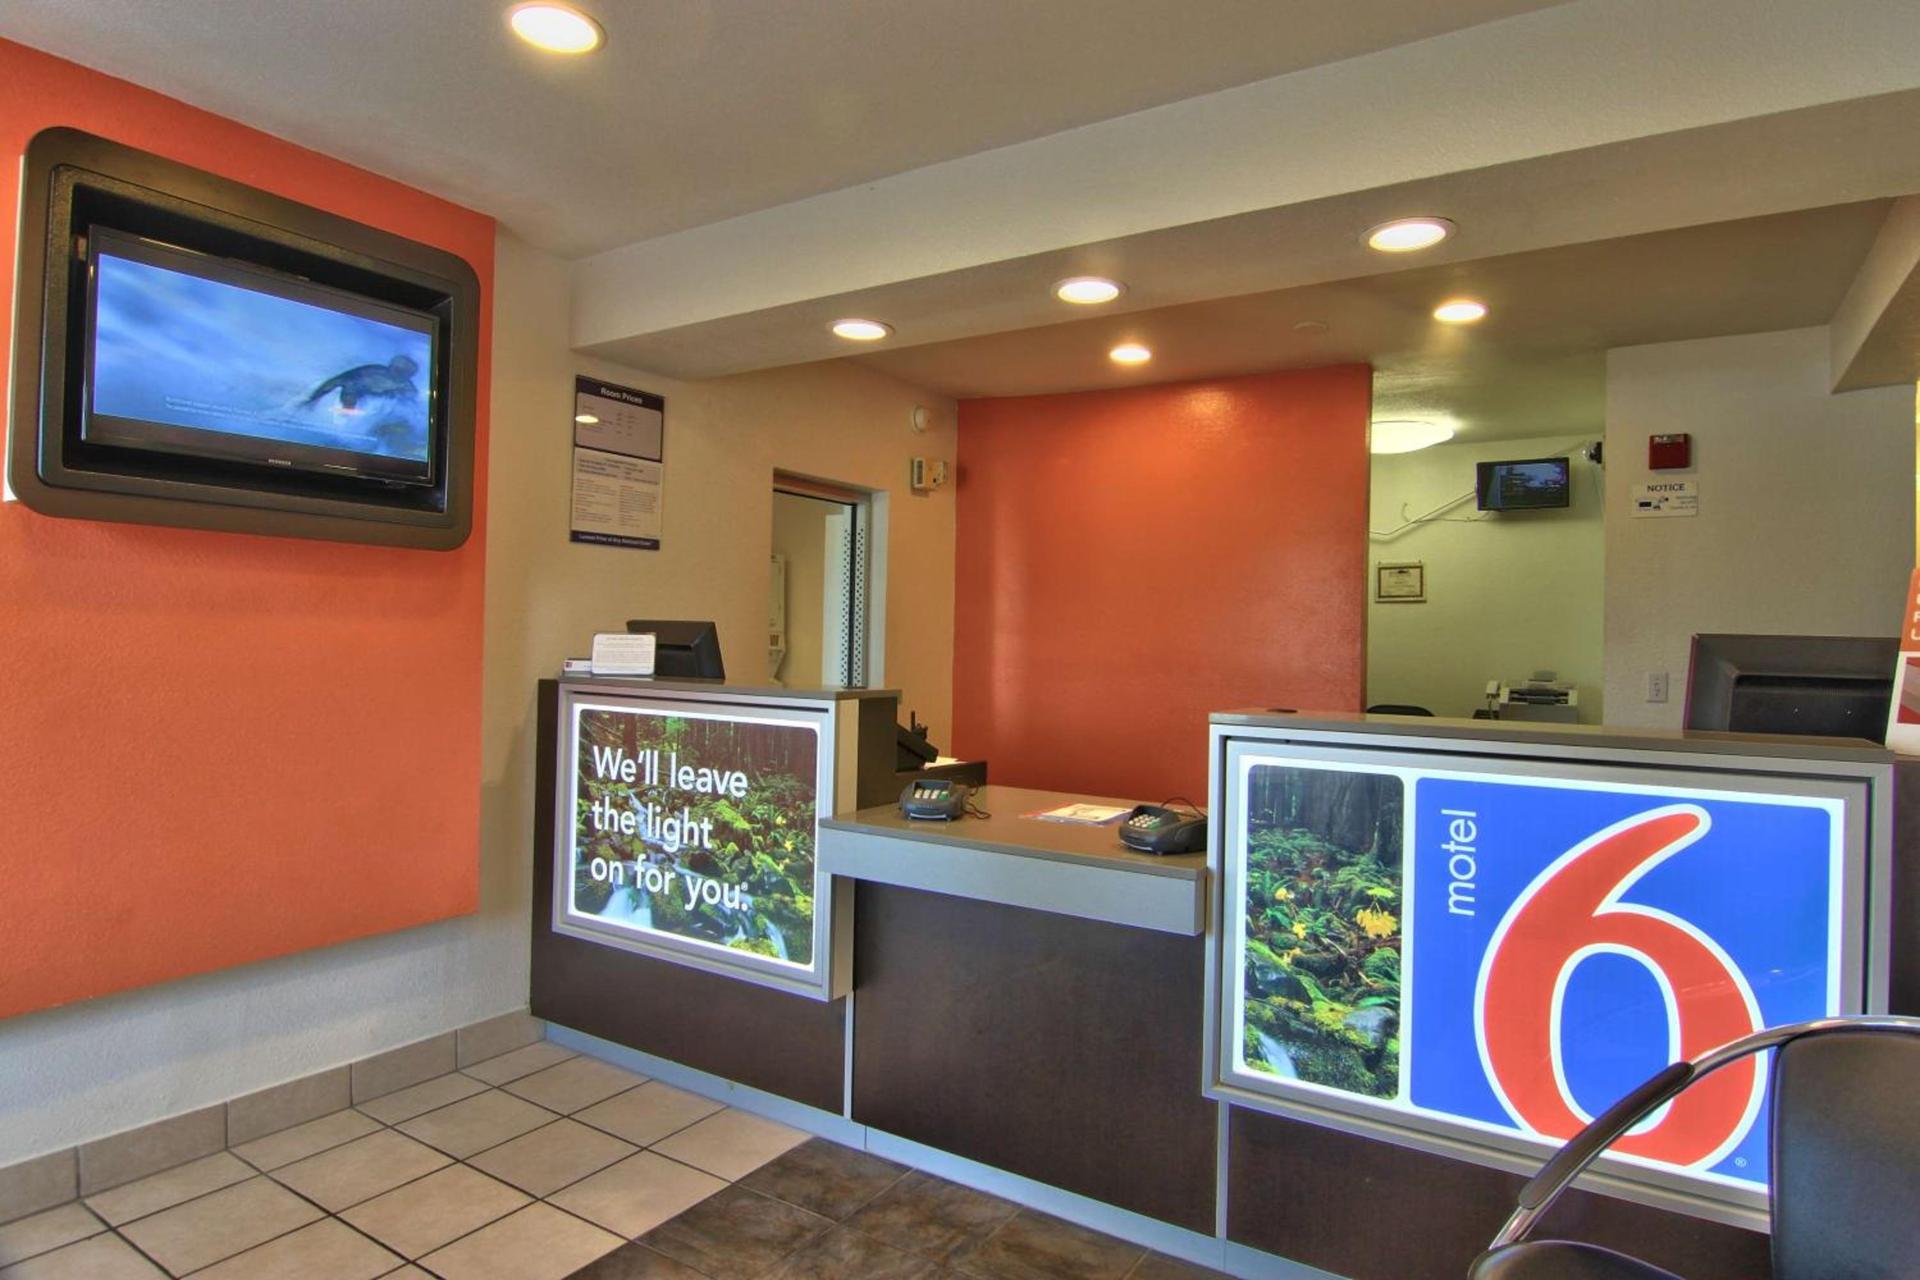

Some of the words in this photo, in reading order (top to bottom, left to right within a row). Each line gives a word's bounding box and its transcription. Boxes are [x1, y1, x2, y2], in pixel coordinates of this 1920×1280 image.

[600, 386, 620, 398] Room
[622, 391, 643, 404] Prices
[1646, 482, 1686, 493] NOTICE
[592, 745, 659, 786] We'll
[670, 751, 749, 798] leave
[591, 795, 636, 835] the
[647, 801, 714, 853] light
[590, 857, 624, 886] on
[634, 853, 676, 895] for
[1440, 808, 1477, 917] motel
[1474, 803, 1769, 1172] 6
